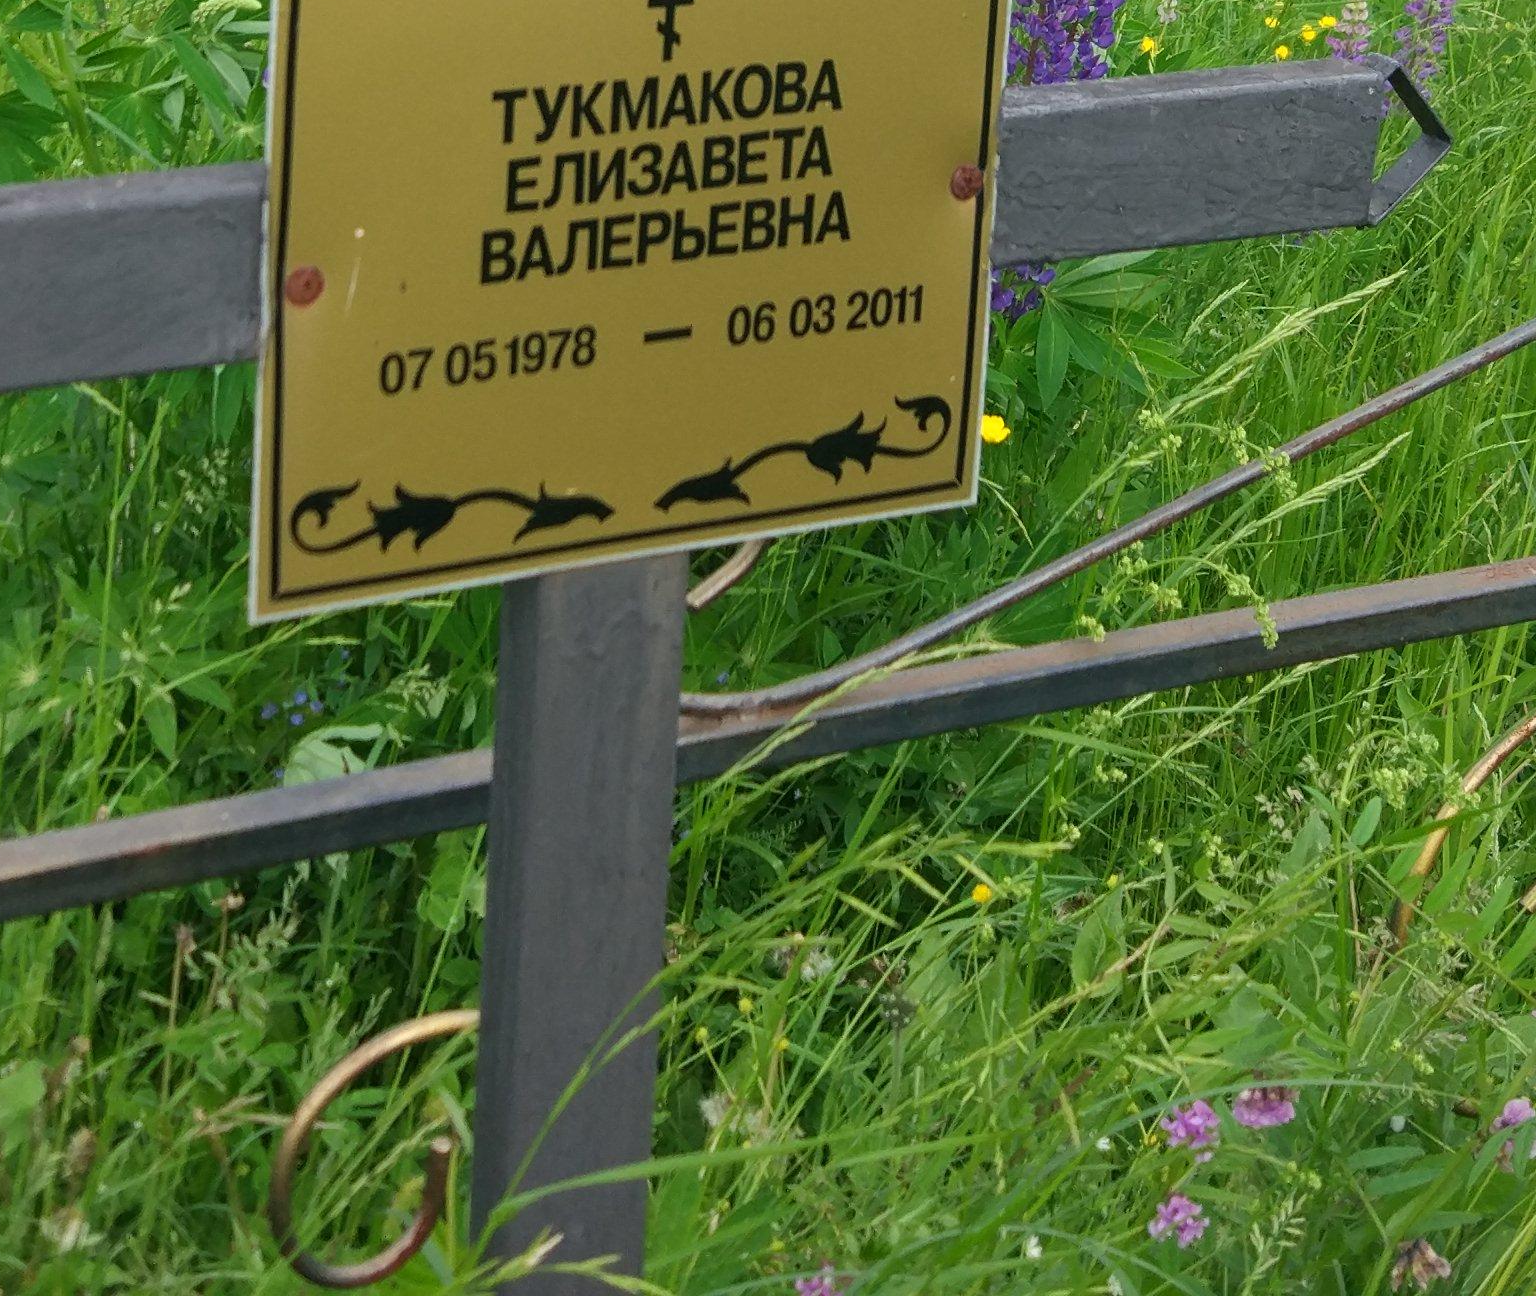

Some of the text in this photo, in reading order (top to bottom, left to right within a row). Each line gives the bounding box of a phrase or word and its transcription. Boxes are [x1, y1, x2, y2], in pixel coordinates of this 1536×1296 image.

[492, 59, 843, 145] ТУКМАКОВА
[505, 125, 833, 214] ЕЛИЗАВЕТА
[479, 190, 852, 286] ВАЛЕРЬЕВНА
[378, 347, 434, 397] 07
[726, 301, 777, 348] 06
[788, 293, 836, 340] 03
[845, 284, 925, 333] 2011
